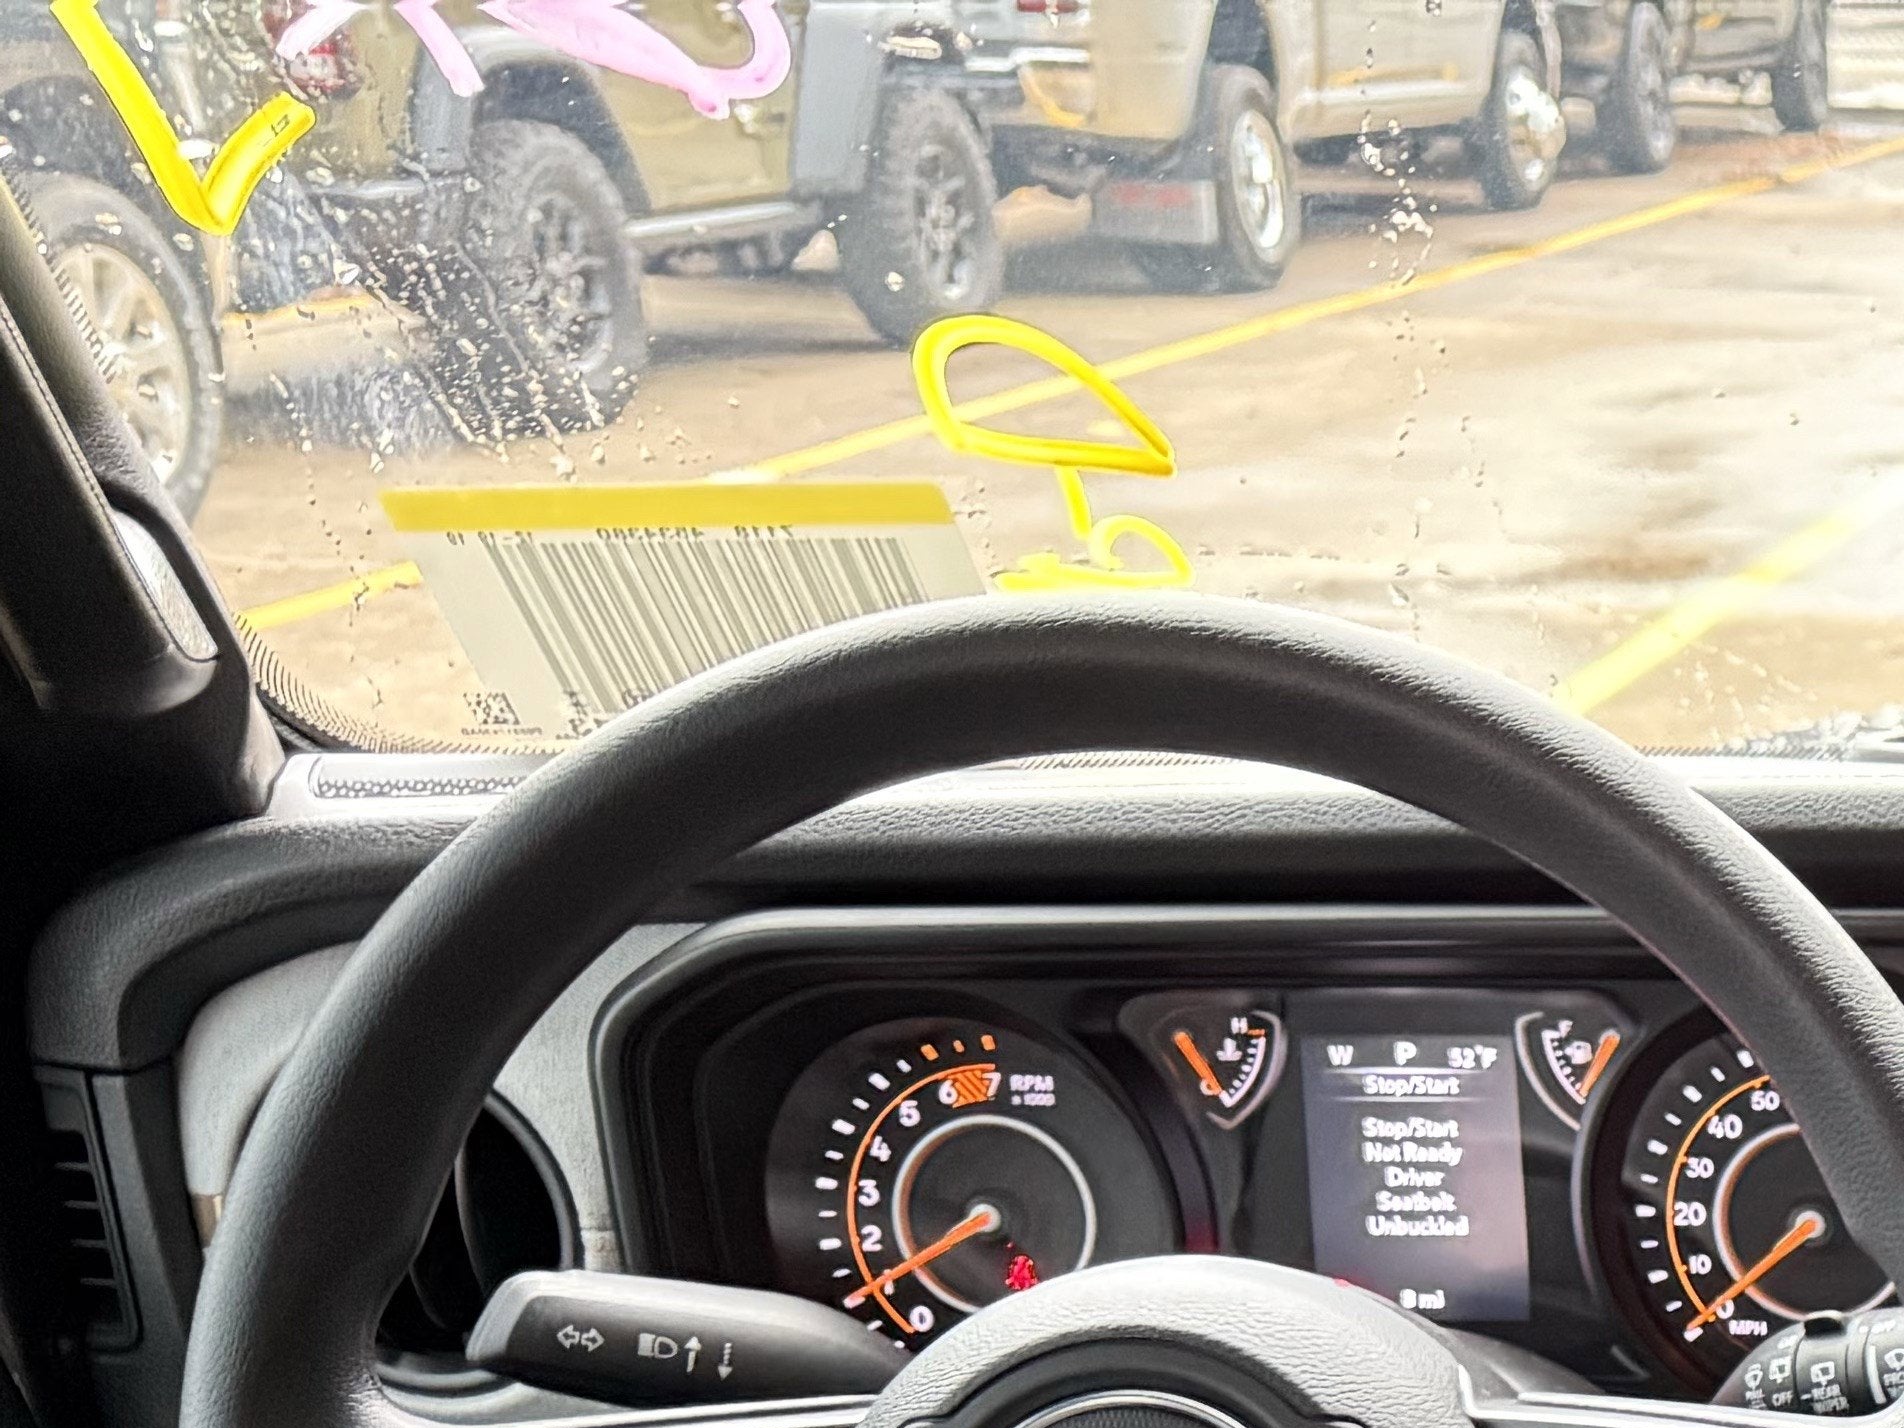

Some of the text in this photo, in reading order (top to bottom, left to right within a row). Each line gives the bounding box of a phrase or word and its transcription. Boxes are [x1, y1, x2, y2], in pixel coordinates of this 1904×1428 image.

[1327, 1044, 1354, 1066] W
[1393, 1041, 1417, 1065] P
[938, 1080, 958, 1105] 6
[982, 1072, 1001, 1097] 7
[1009, 1074, 1054, 1092] RPM
[1361, 1075, 1460, 1097] Stop/Start
[1750, 1090, 1780, 1111] 50
[899, 1100, 921, 1127] 5
[1361, 1116, 1460, 1141] Stop/Start
[1707, 1114, 1743, 1139] 40
[869, 1135, 892, 1162] 4
[1361, 1141, 1464, 1166] Not Ready
[1384, 1166, 1446, 1188] Driver
[1686, 1157, 1715, 1179] 30
[858, 1179, 880, 1207] 3
[1375, 1190, 1458, 1212] Seatbelt
[1365, 1214, 1470, 1237] Unbuckled
[1673, 1202, 1707, 1226] 20
[860, 1224, 883, 1251] 2
[1687, 1254, 1713, 1275] 10
[908, 1305, 935, 1332] 0
[1715, 1299, 1735, 1320] 0
[1729, 1320, 1769, 1336] MPH
